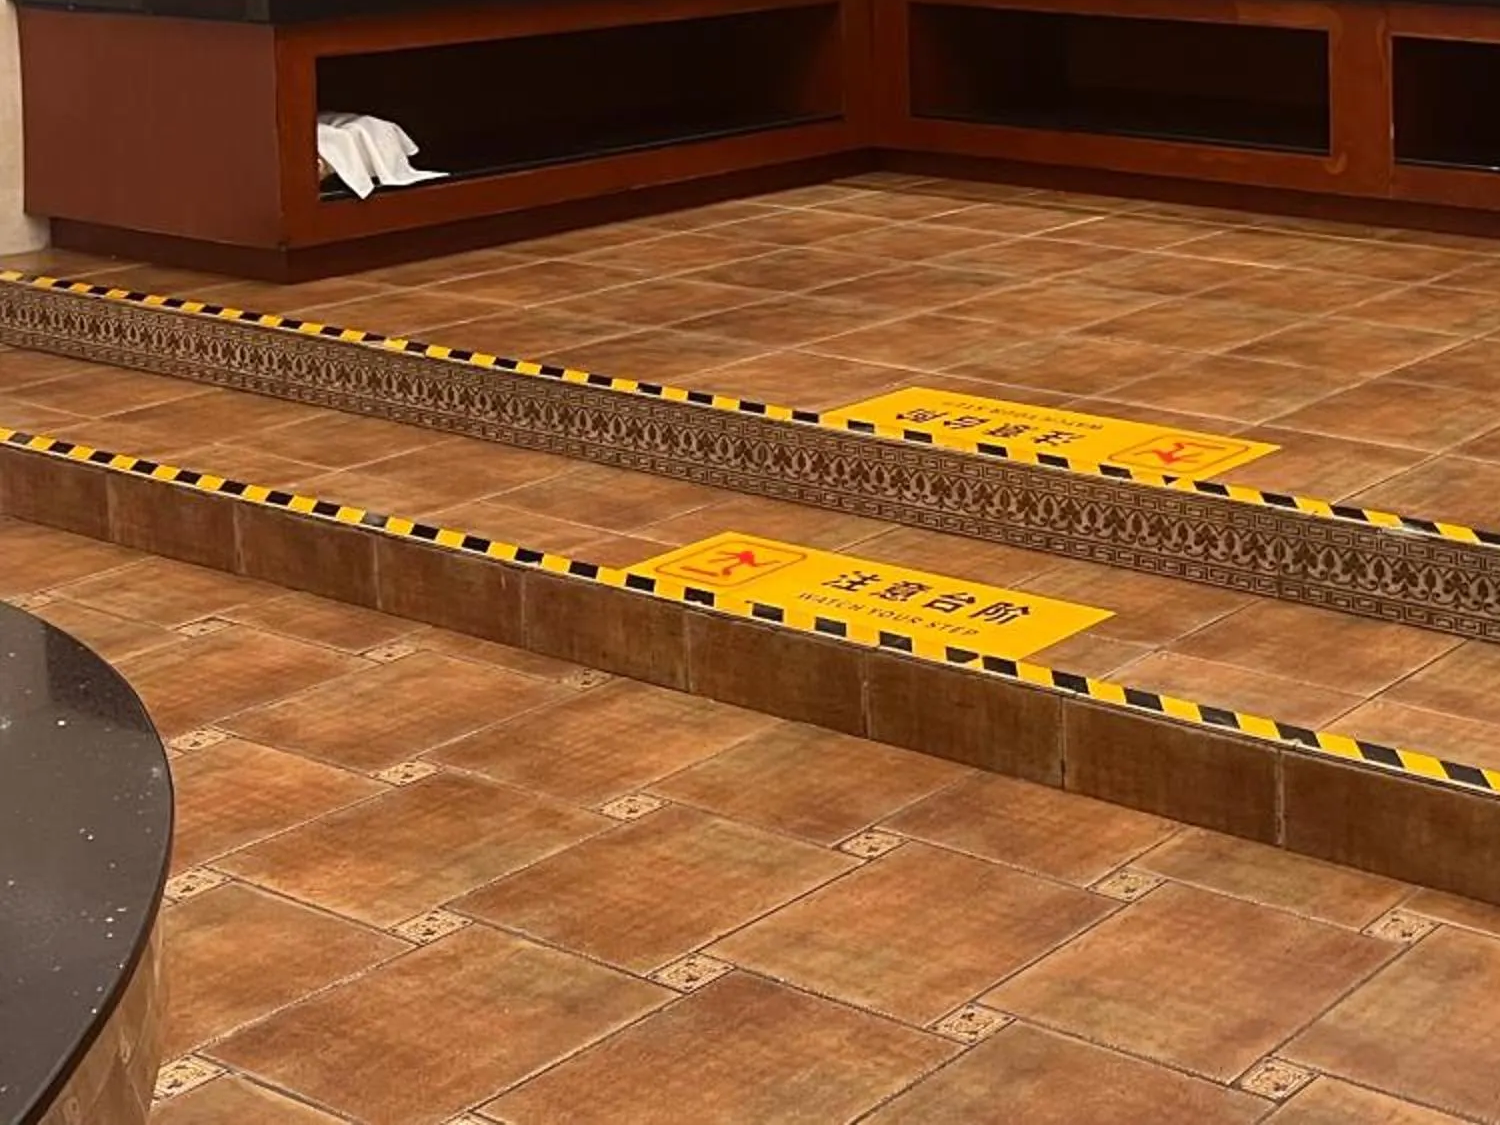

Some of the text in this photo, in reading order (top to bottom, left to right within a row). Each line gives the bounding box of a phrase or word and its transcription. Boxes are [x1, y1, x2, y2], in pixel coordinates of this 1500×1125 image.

[798, 591, 980, 638] WATCH YOUR STEP
[821, 571, 1031, 625] 注意台阶
